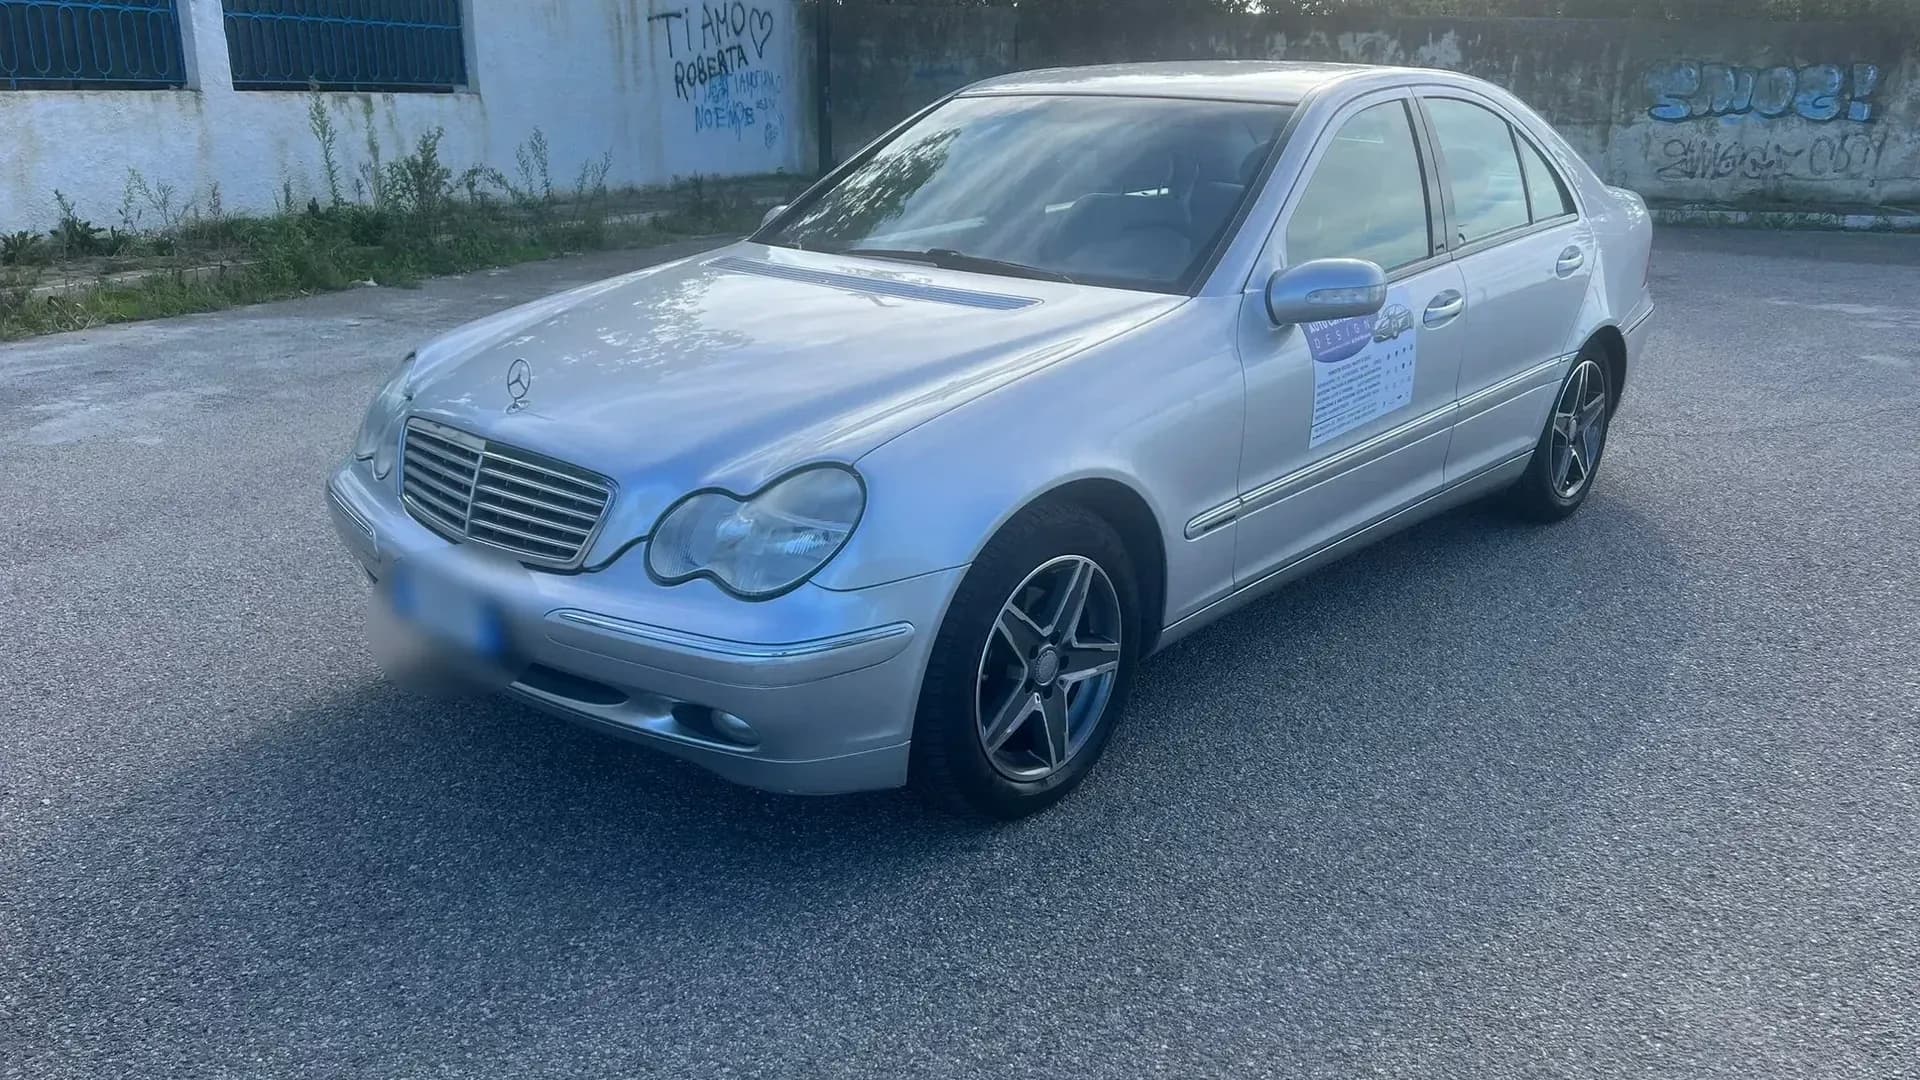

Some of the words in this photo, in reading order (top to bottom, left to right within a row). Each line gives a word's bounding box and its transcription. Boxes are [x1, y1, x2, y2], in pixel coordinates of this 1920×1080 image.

[701, 1, 746, 49] AMO
[674, 44, 749, 102] ROBERTA
[1313, 318, 1372, 350] DESIGN
